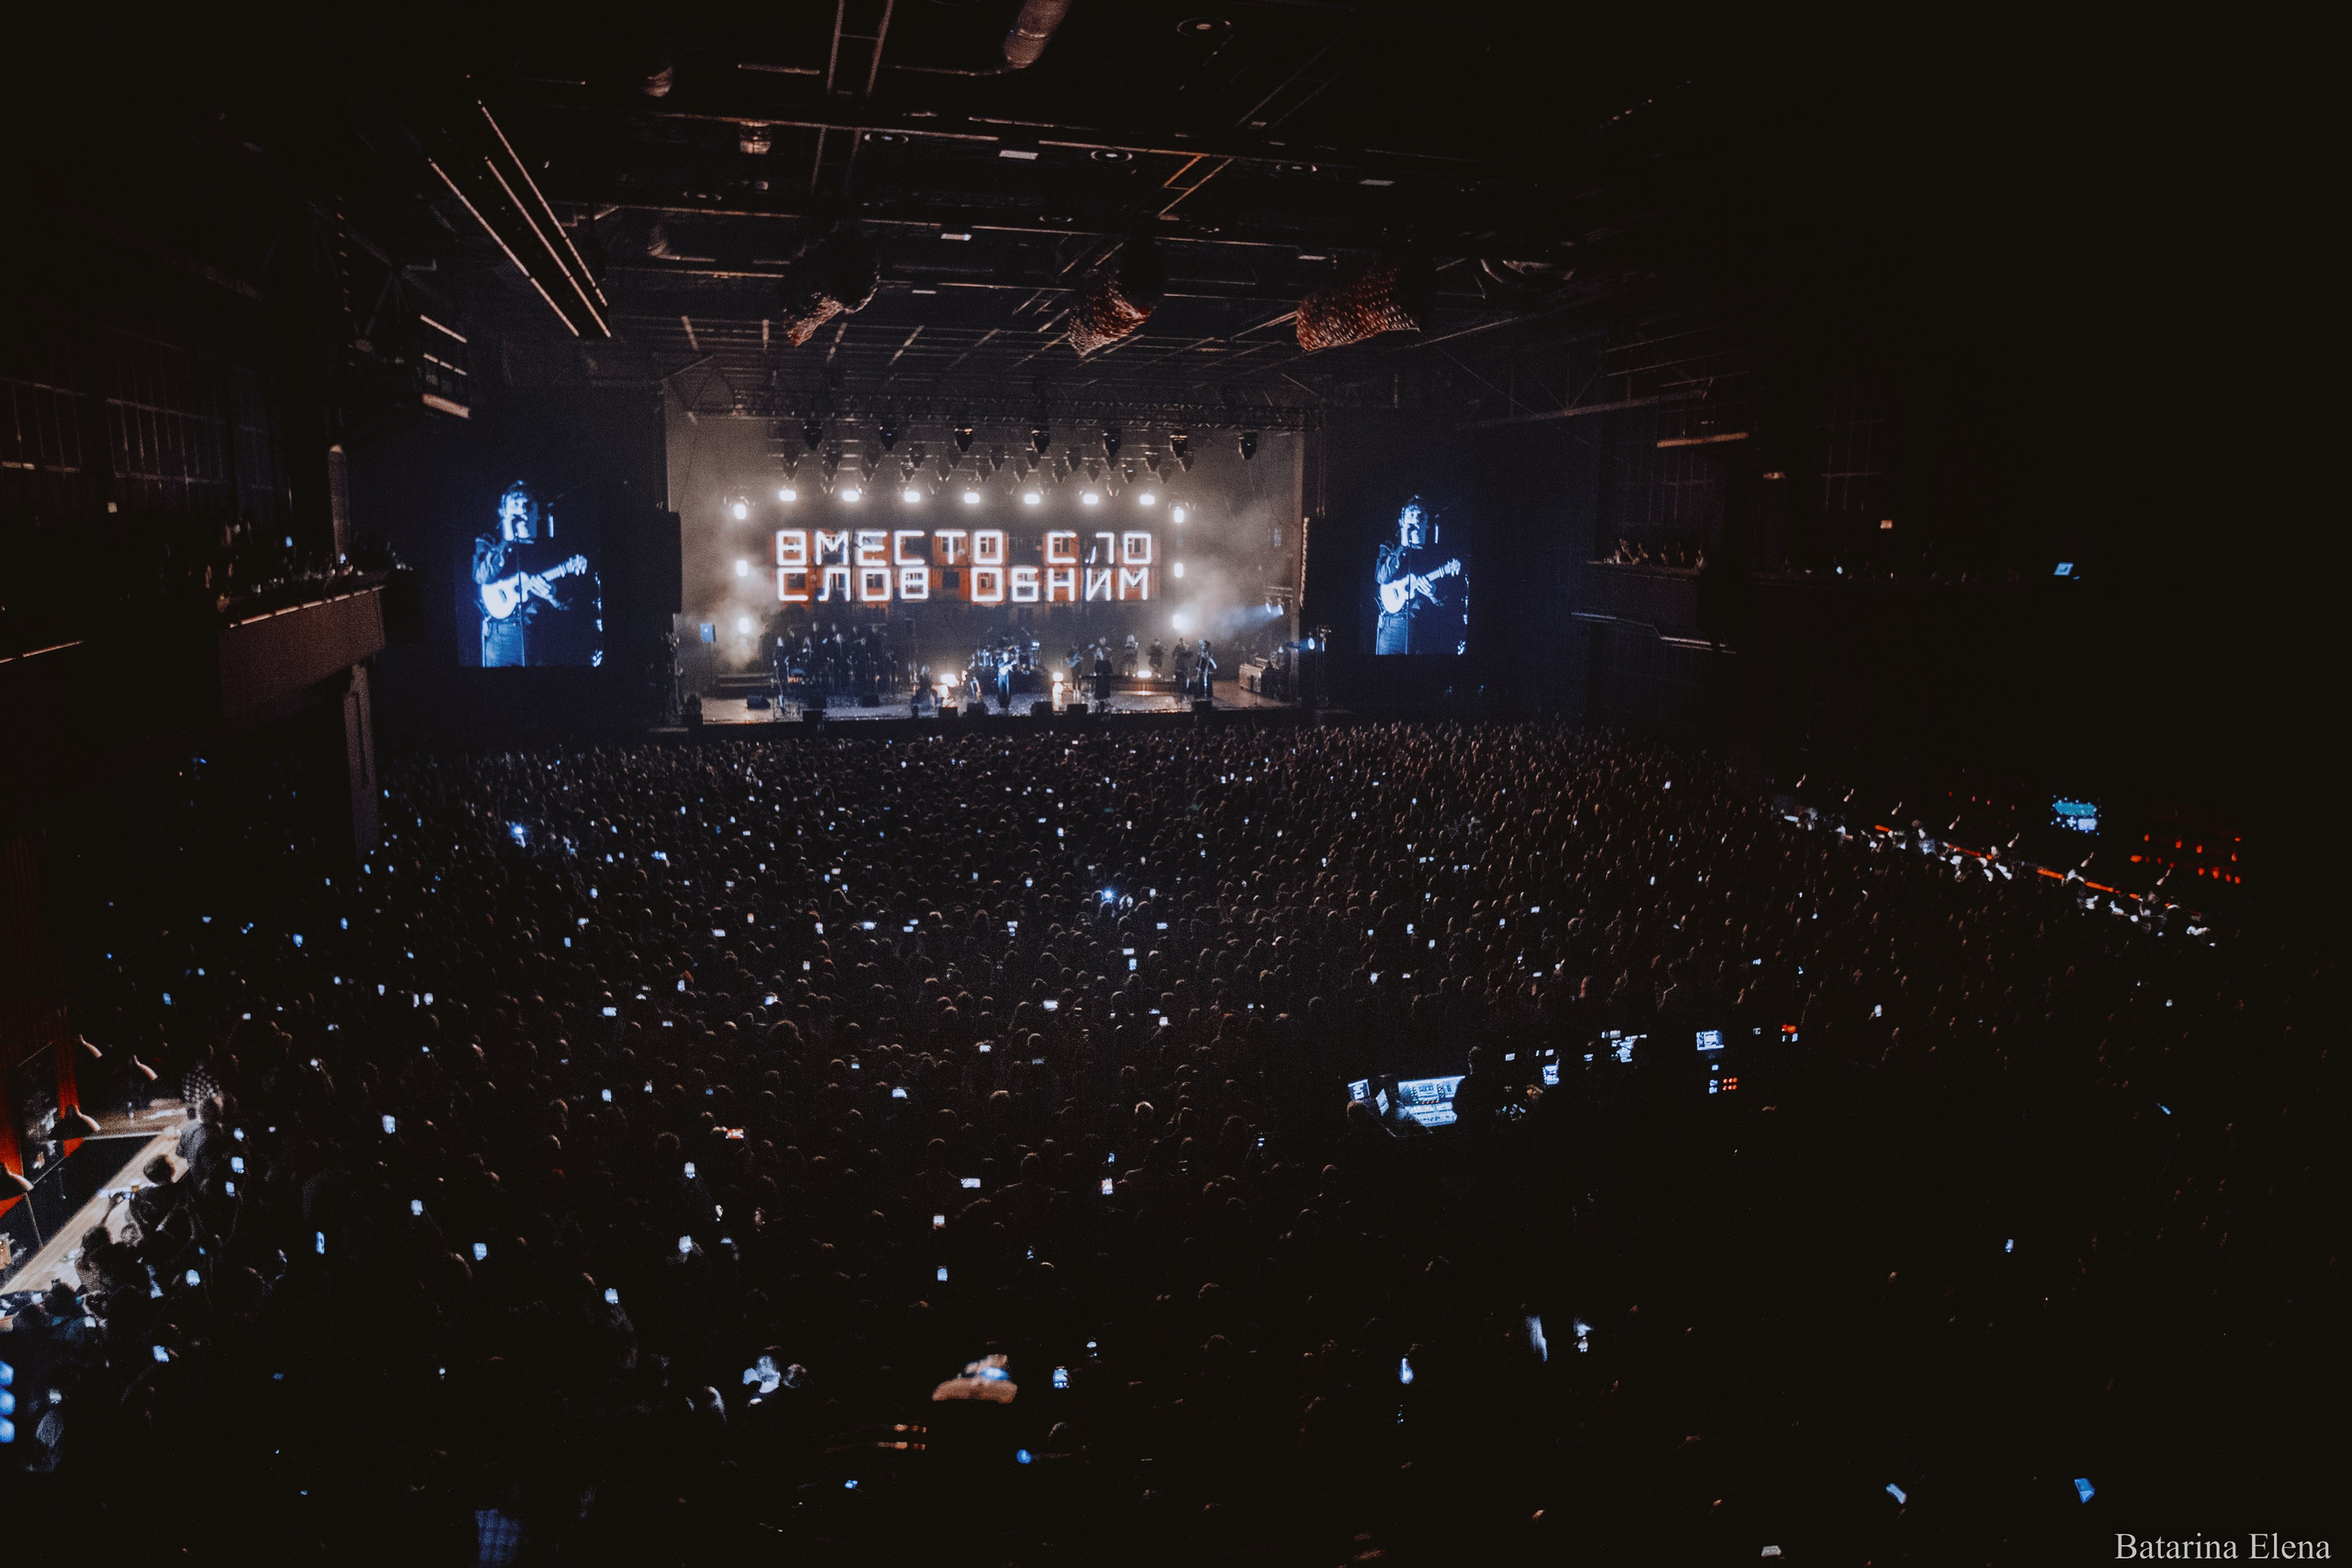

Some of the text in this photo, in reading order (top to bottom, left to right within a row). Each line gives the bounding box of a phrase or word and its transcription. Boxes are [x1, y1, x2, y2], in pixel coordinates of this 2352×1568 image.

[776, 530, 1003, 566] ВМЕСТО
[776, 567, 1148, 603] СЛОВ ОБНИМ
